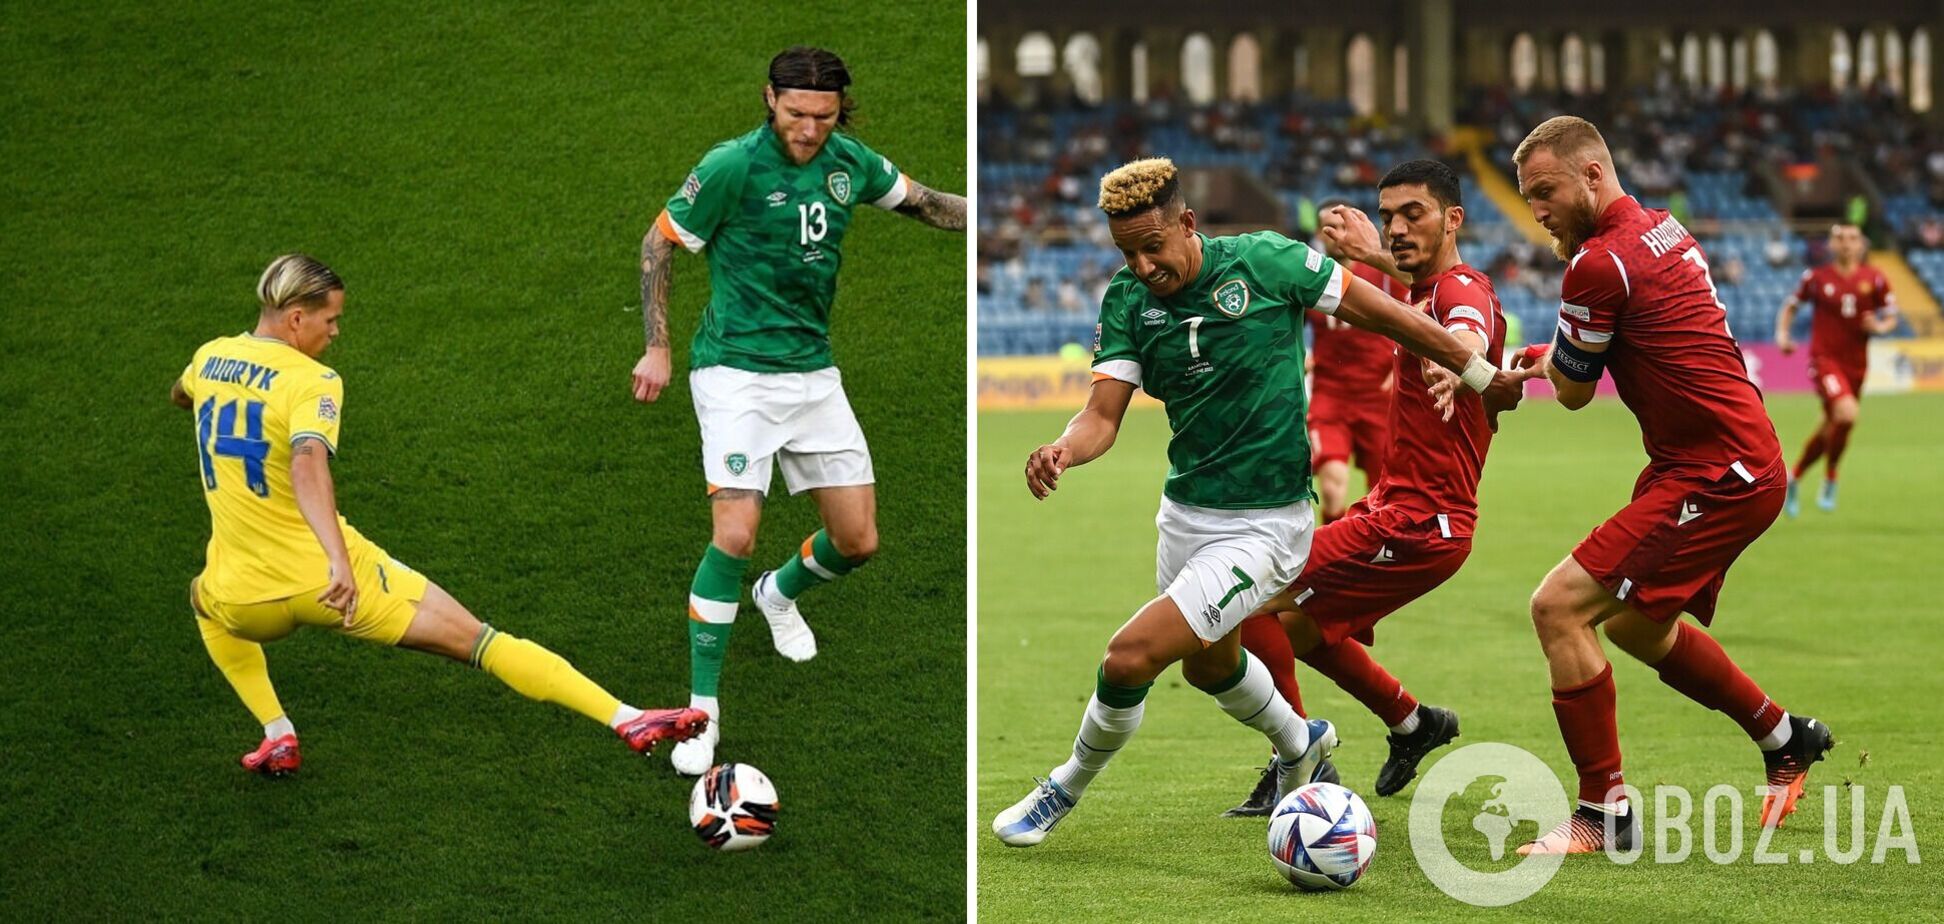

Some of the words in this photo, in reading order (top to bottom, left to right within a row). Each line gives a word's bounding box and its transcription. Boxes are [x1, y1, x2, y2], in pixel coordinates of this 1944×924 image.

[798, 201, 828, 245] 13
[1179, 316, 1205, 358] 7
[200, 355, 279, 391] MUDRYK
[1557, 349, 1590, 371] RESPECT
[198, 395, 271, 498] 14
[1217, 565, 1255, 610] 7
